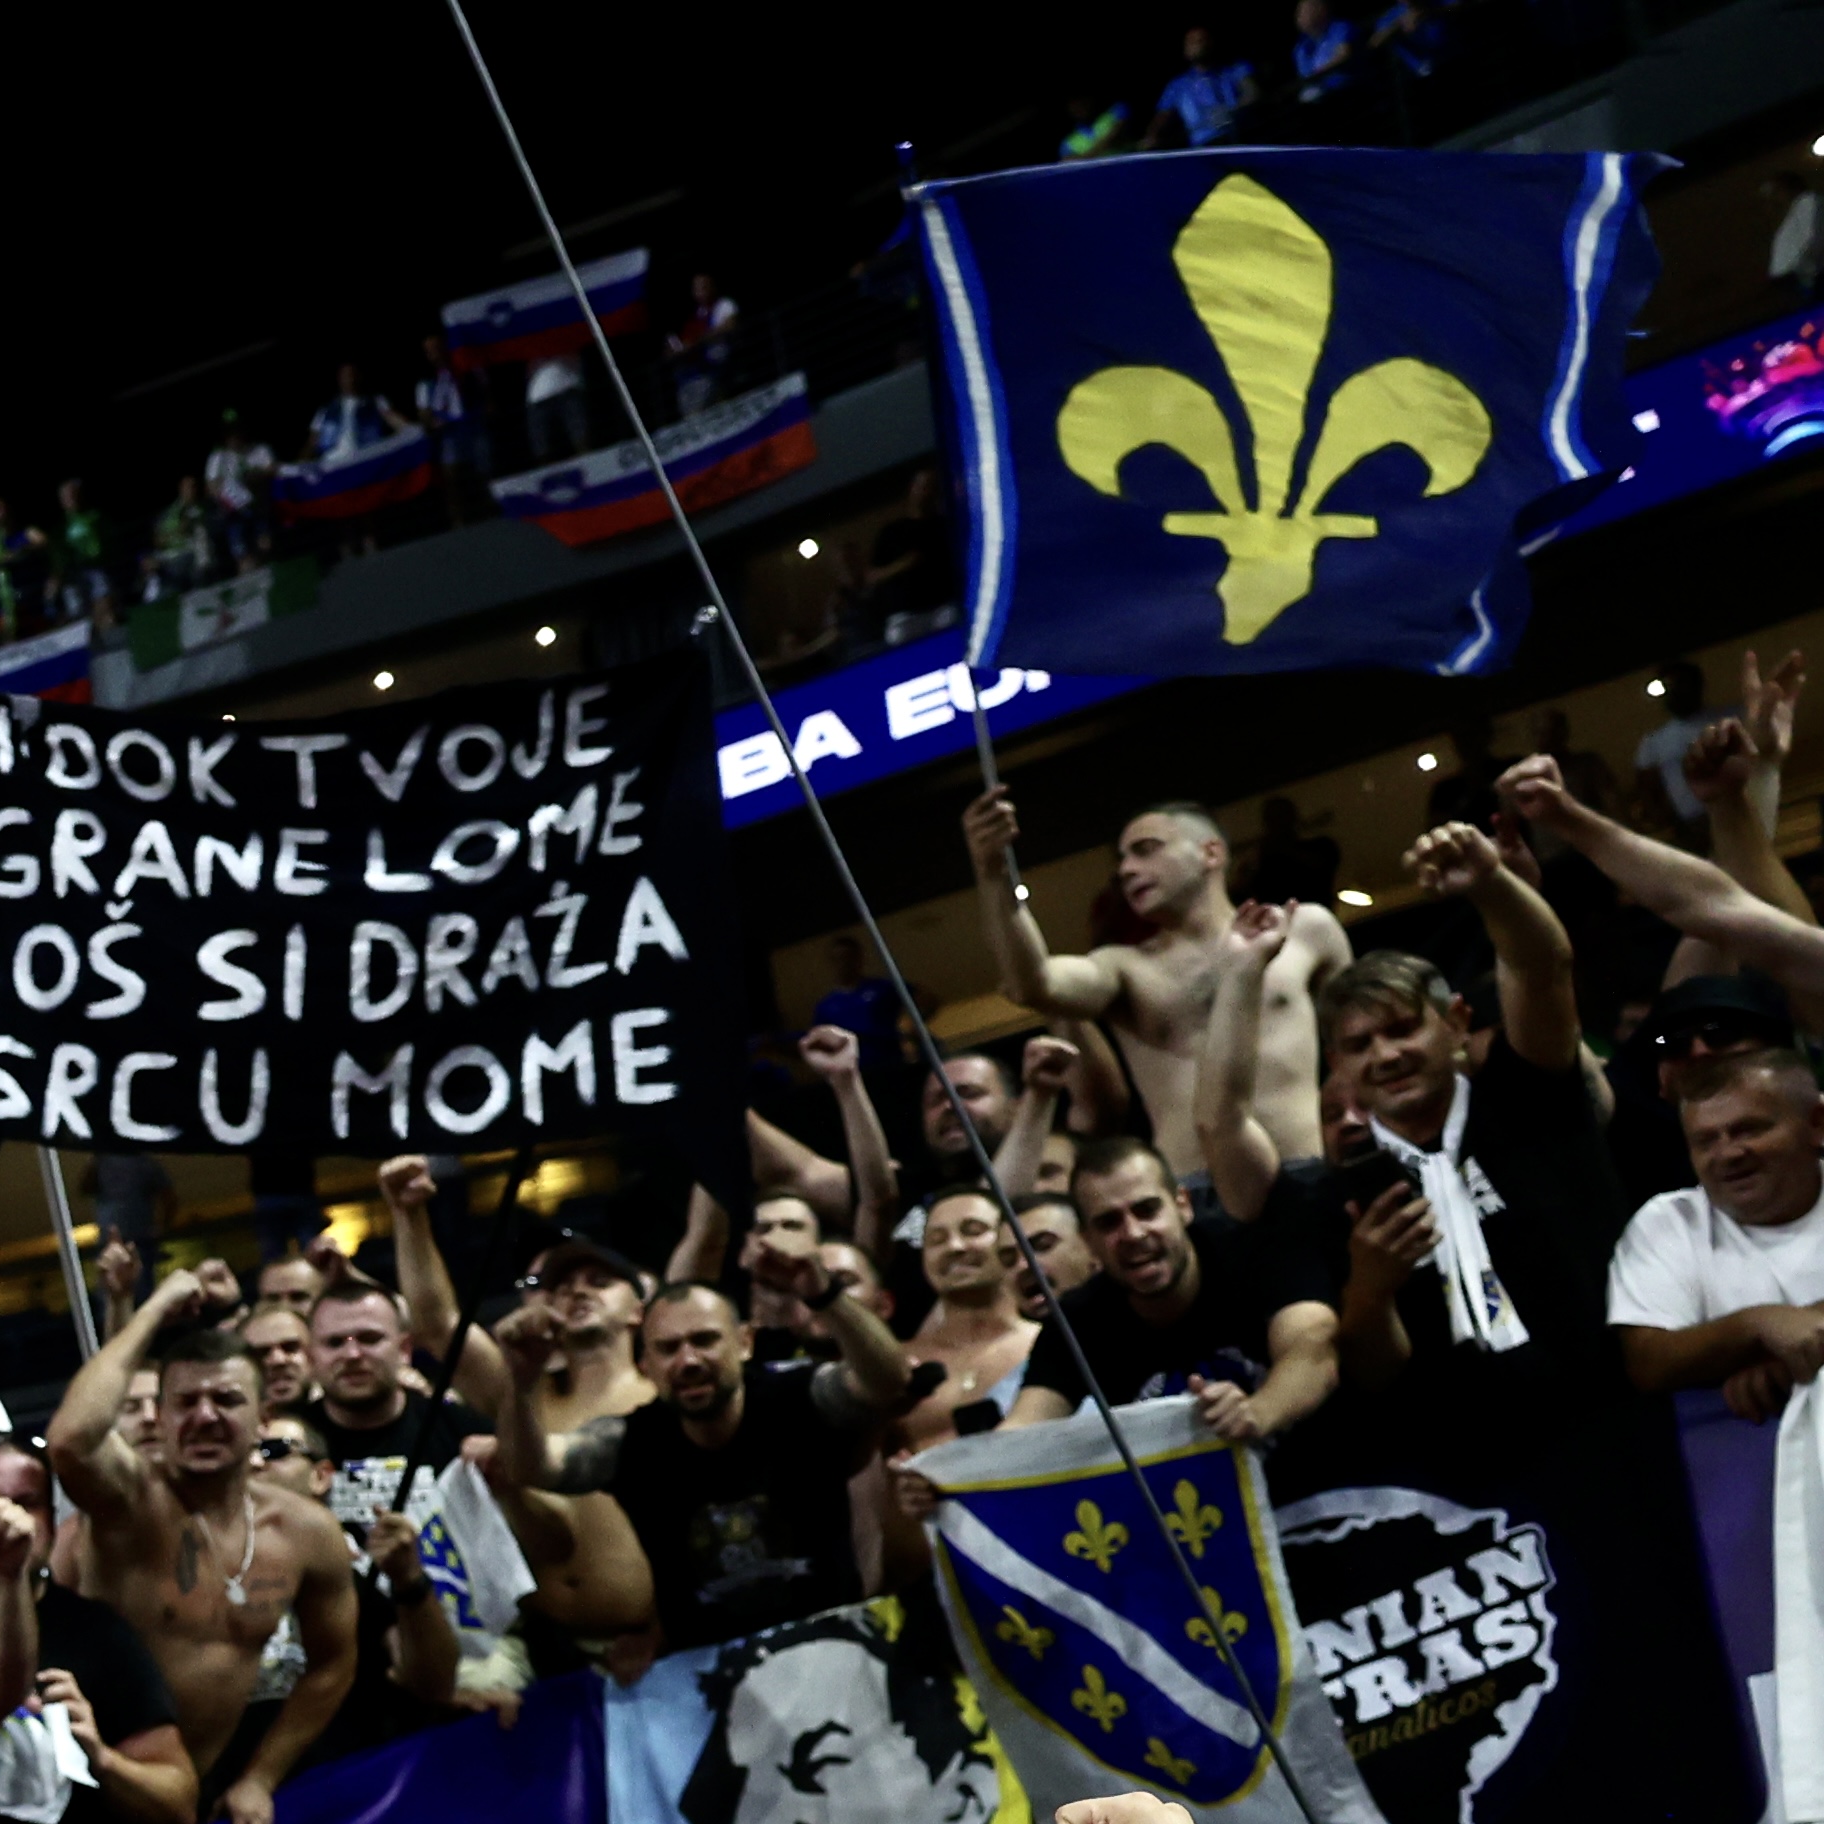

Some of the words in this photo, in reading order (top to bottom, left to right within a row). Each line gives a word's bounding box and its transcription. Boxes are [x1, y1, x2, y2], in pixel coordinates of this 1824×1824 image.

[45, 722, 239, 808] DOK
[717, 708, 863, 800] BA
[363, 769, 645, 893] LOME
[196, 923, 305, 1022] SI
[350, 876, 691, 1023] DRAŽA
[330, 1006, 679, 1141] MOME
[1303, 1531, 1546, 1678] NIAN
[1319, 1599, 1539, 1724] RAS
